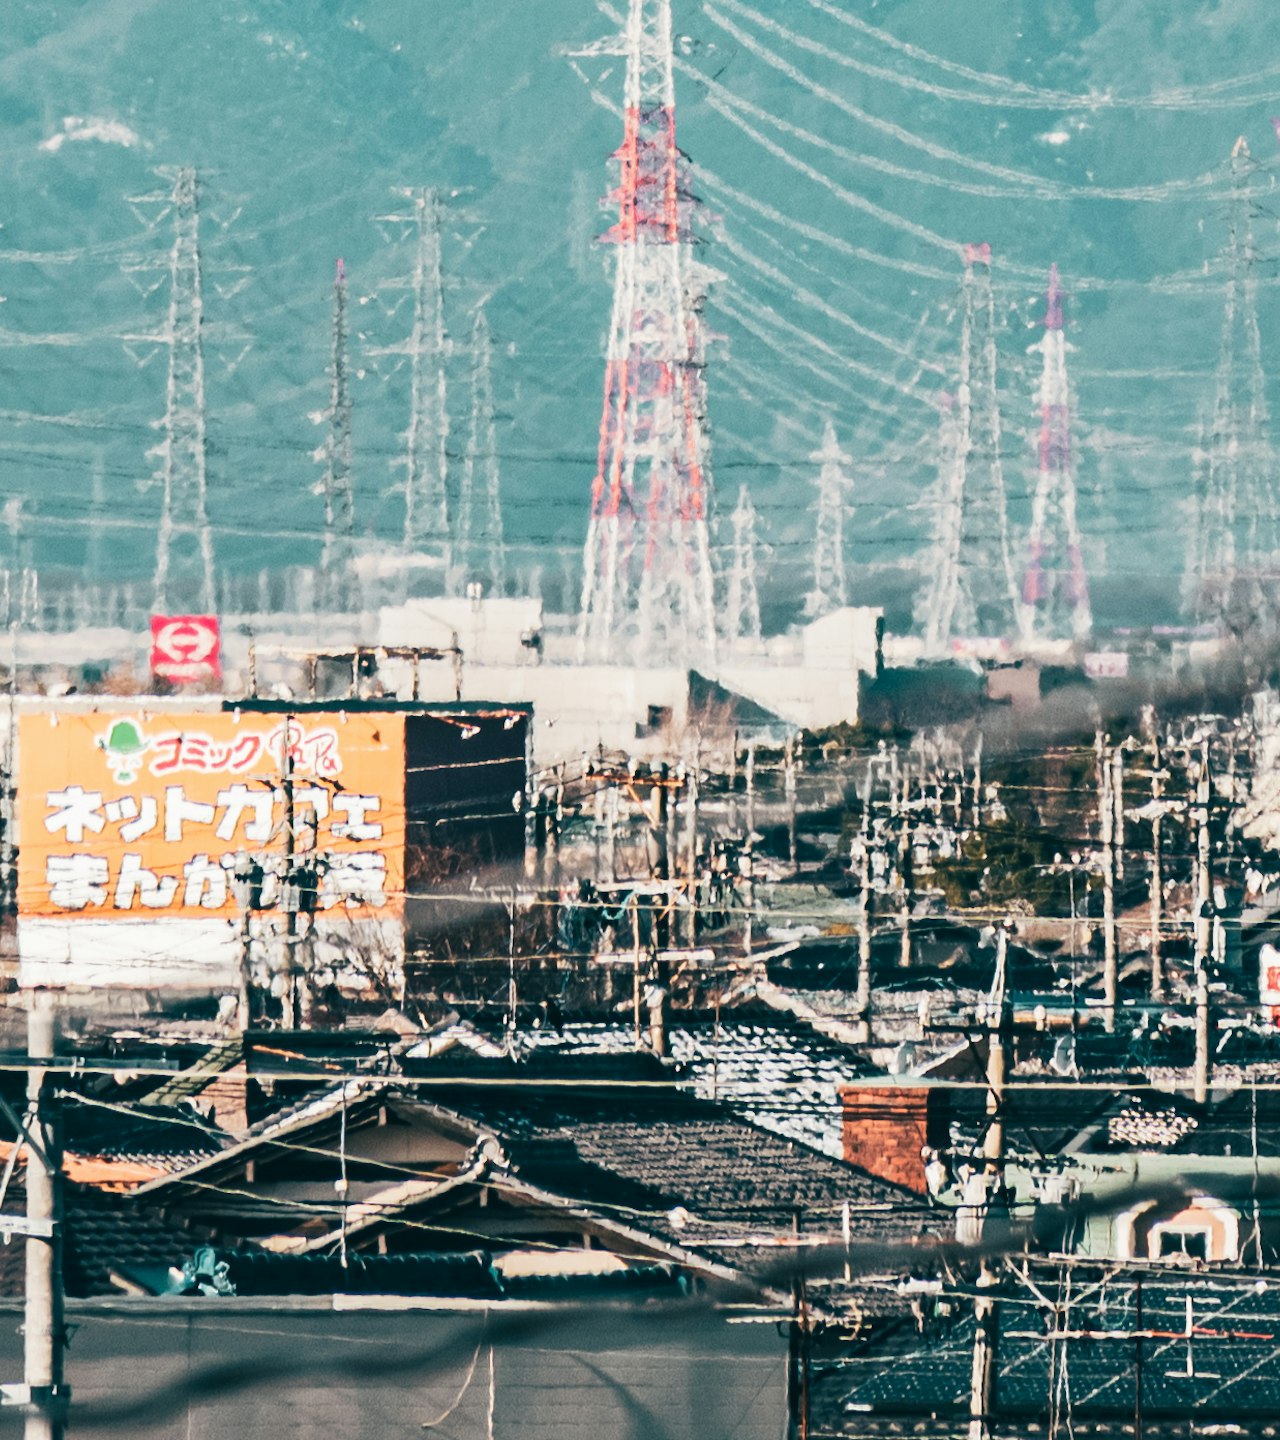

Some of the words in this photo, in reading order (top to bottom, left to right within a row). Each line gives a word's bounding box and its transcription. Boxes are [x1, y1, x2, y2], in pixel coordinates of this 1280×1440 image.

[153, 736, 260, 770] コミック
[44, 783, 383, 842] ネットカフェ
